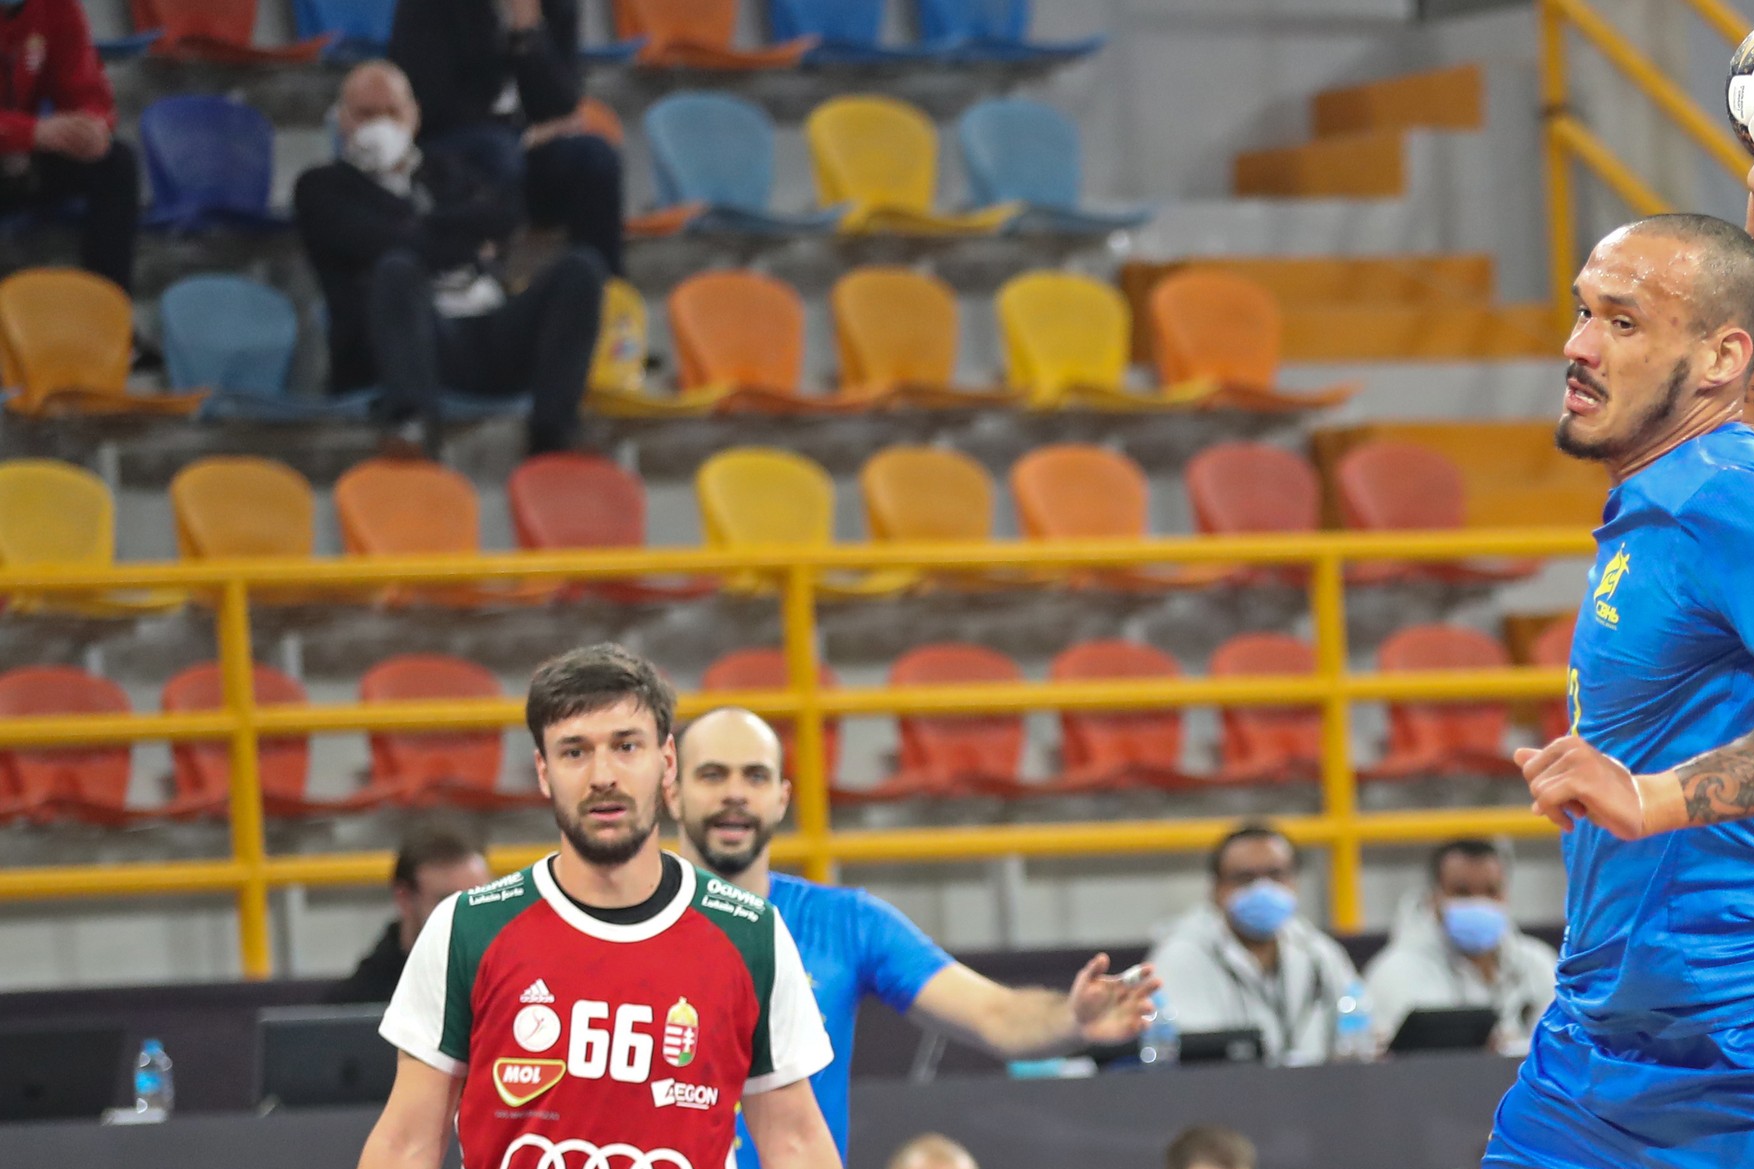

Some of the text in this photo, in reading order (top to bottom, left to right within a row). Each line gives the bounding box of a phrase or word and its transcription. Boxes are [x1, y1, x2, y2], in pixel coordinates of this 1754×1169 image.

[566, 999, 654, 1084] 66
[502, 1065, 541, 1084] MOL
[666, 1083, 719, 1106] AEGON
